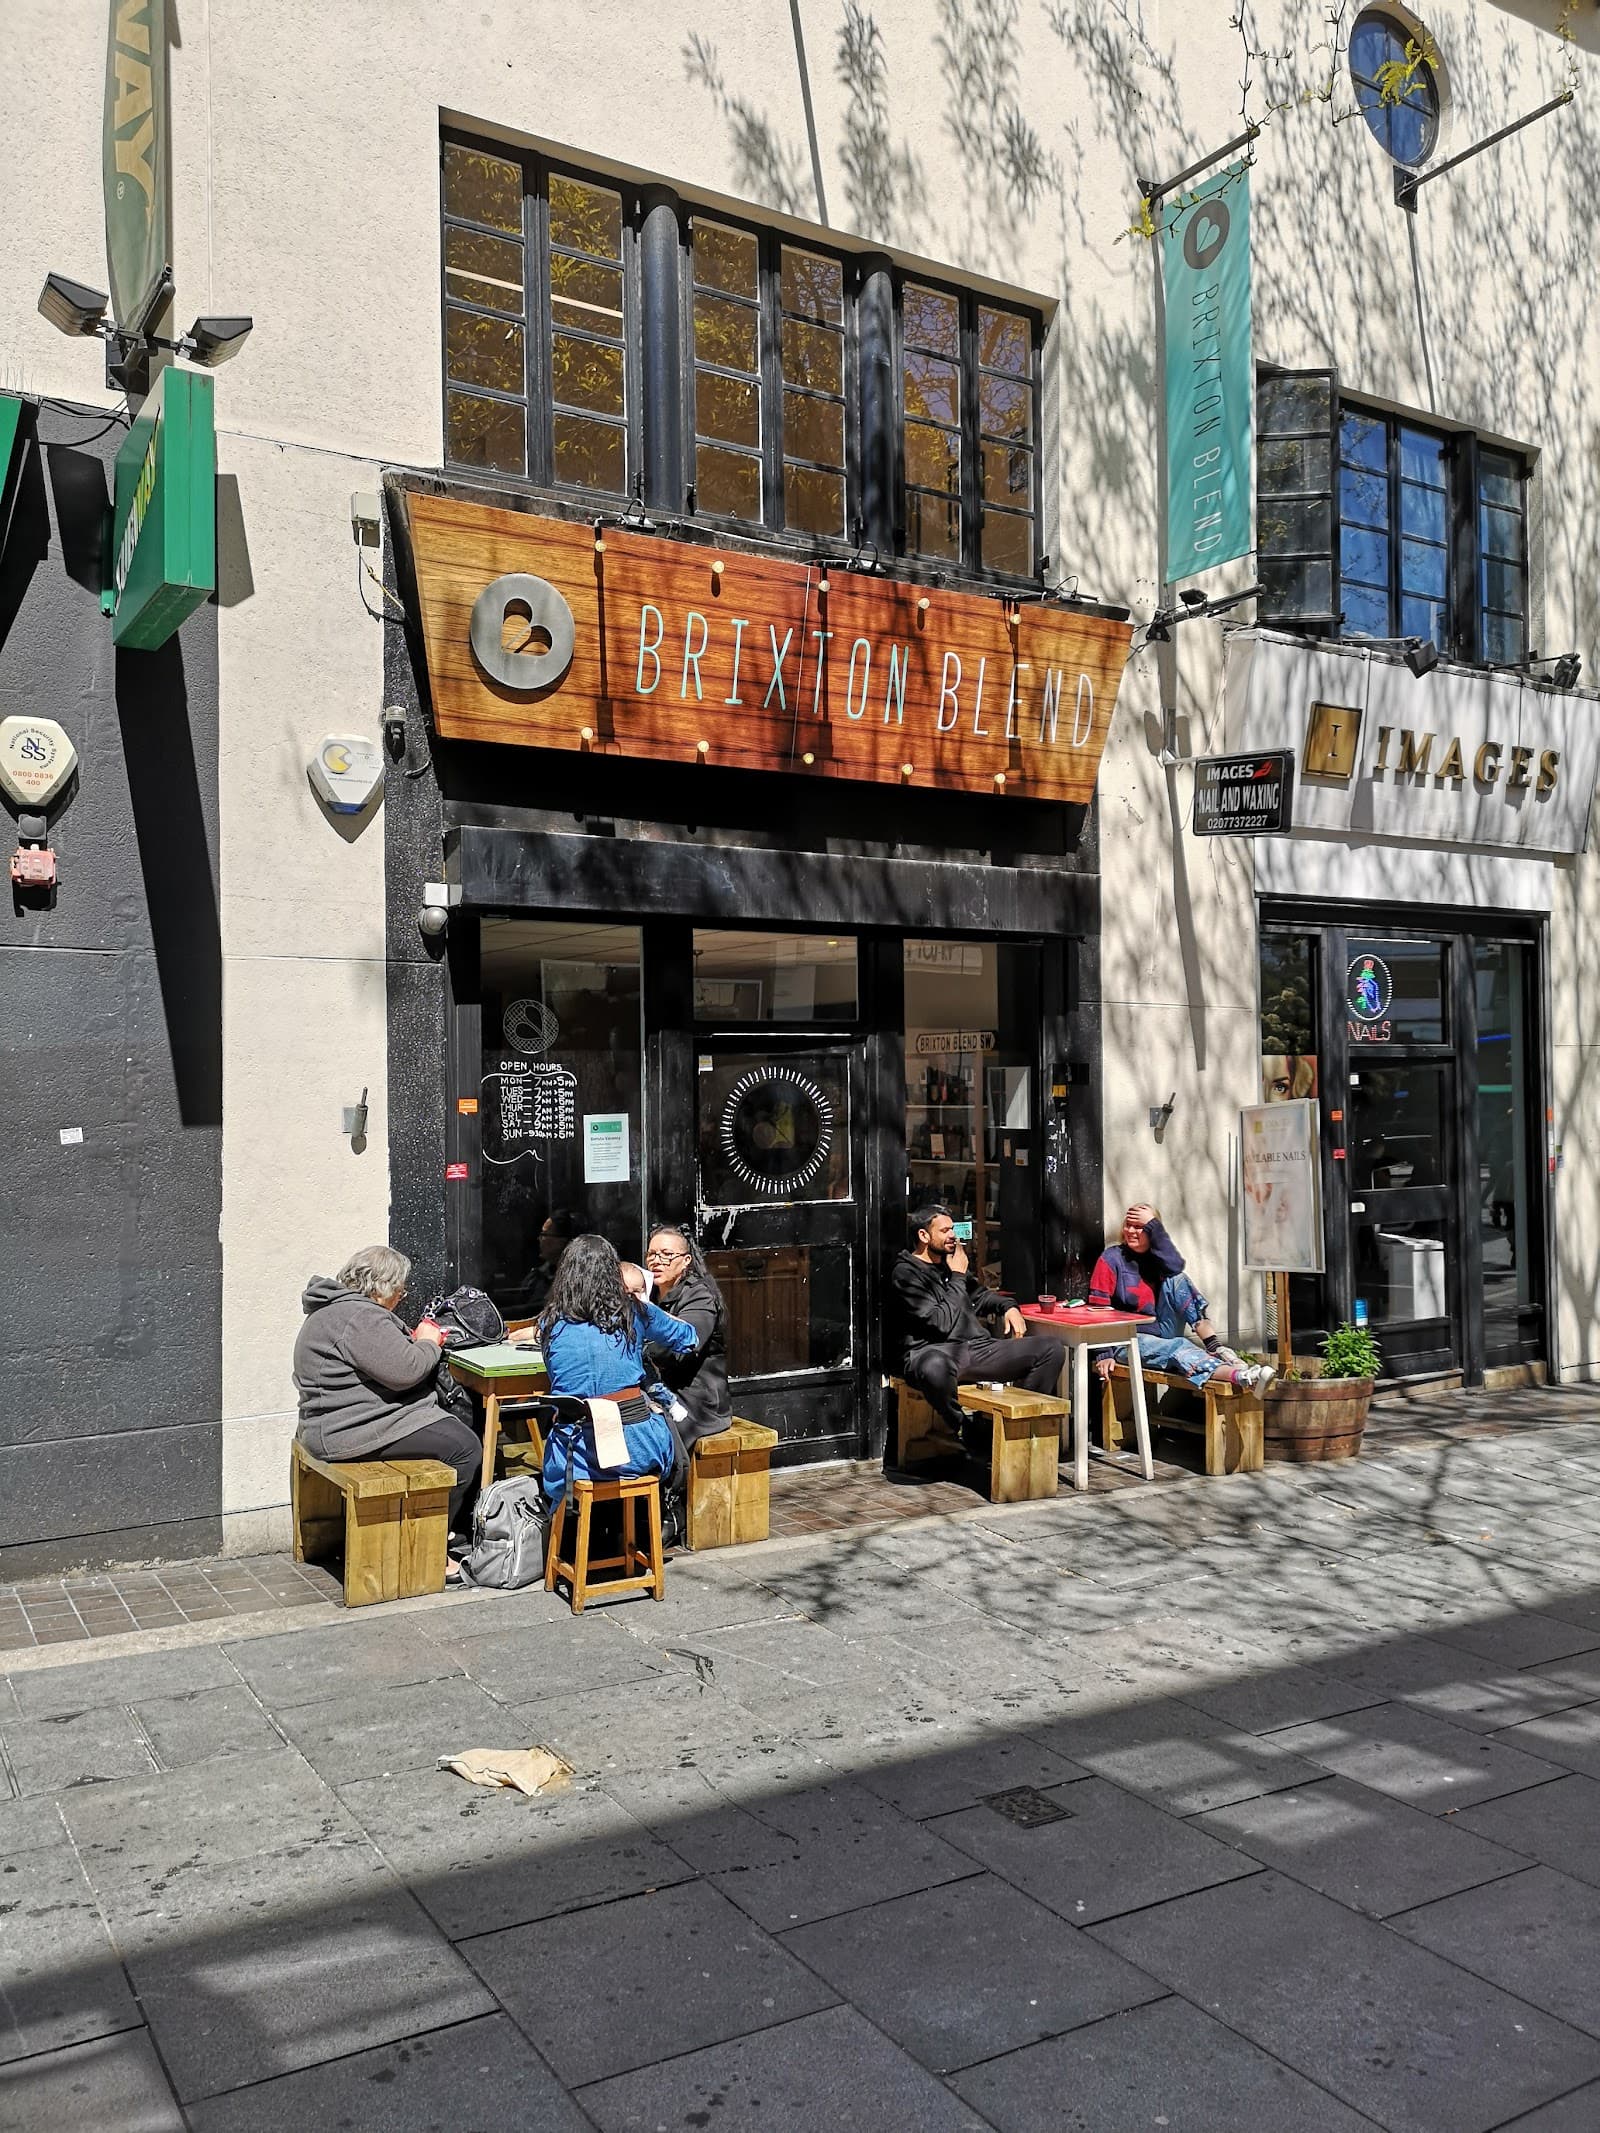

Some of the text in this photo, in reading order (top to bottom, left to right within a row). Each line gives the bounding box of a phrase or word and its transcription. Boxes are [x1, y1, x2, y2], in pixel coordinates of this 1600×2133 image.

[1191, 283, 1222, 553] BRIXTON BLEND
[636, 604, 1094, 748] BRIXTON BLEND
[1372, 725, 1561, 793] IMAGES
[1207, 764, 1255, 781] IMAGES
[1199, 783, 1280, 814] NAIL AND WAXING
[1207, 815, 1268, 830] 02077372227
[920, 1035, 951, 1052] BRIXTON
[953, 1034, 978, 1050] BLEND
[500, 1061, 563, 1073] OPEN HOURS
